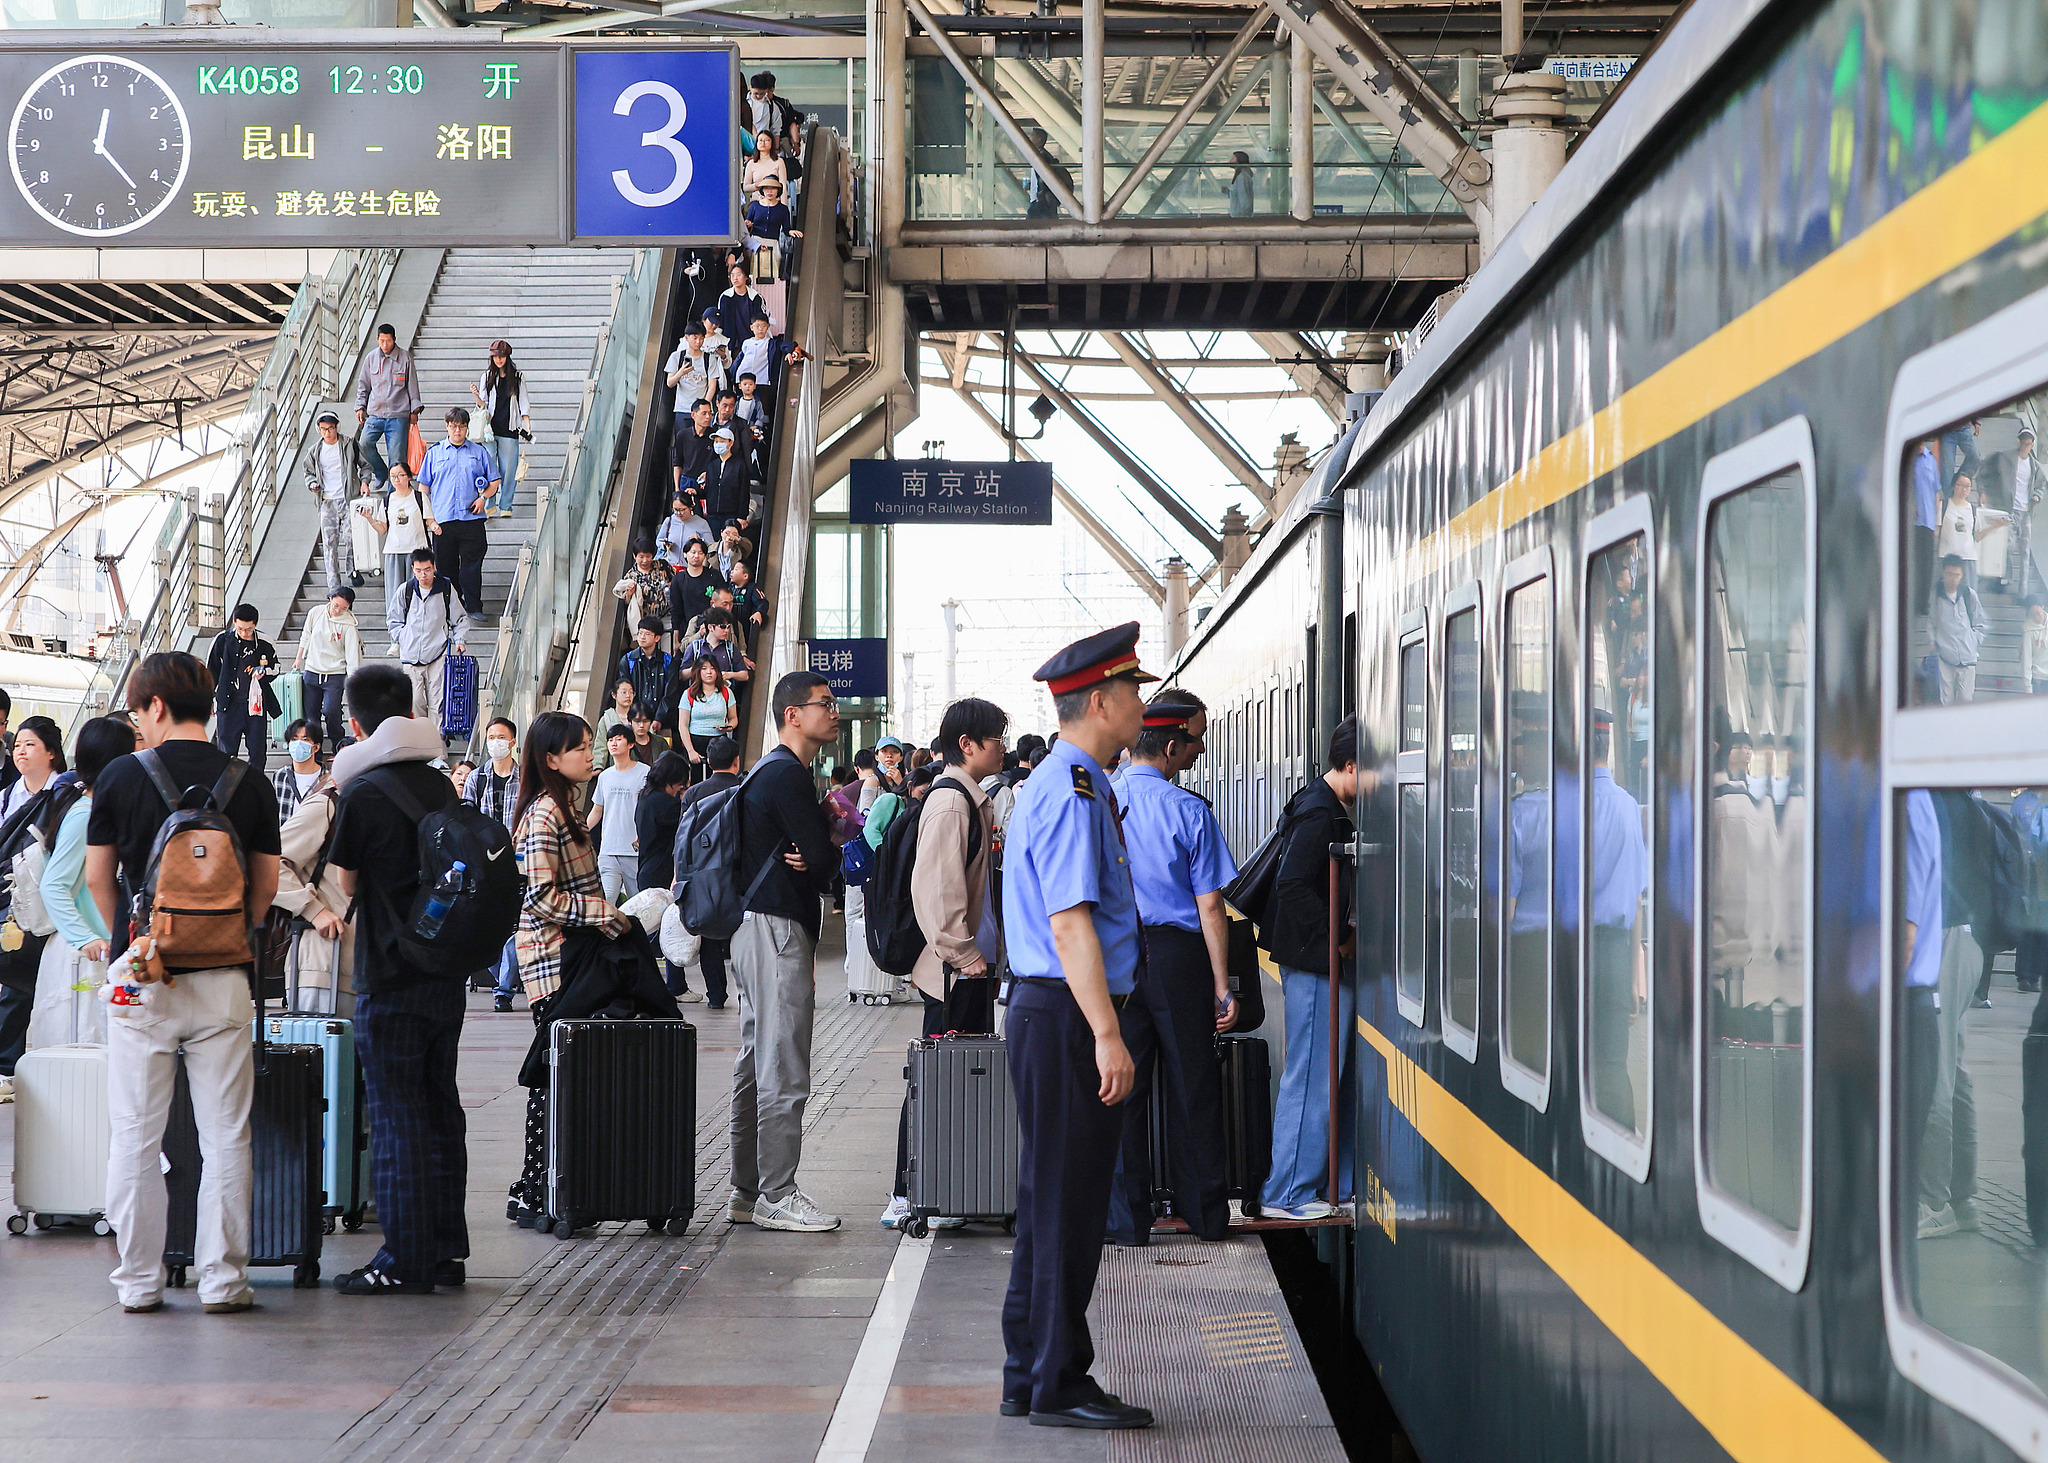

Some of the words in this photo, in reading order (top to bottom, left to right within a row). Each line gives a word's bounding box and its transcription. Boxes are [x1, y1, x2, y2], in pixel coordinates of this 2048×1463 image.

[91, 75, 109, 88] 12
[198, 65, 299, 95] K4058
[328, 65, 424, 95] 12:30
[482, 63, 520, 100] 开
[60, 84, 76, 97] 11
[127, 83, 135, 96] 1
[36, 107, 53, 121] 10
[149, 107, 159, 120] 2
[30, 139, 40, 152] 9
[158, 138, 168, 151] 3
[242, 123, 316, 160] 昆山
[435, 123, 513, 160] 洛阳
[610, 80, 694, 208] 3
[39, 171, 49, 184] 8
[149, 169, 159, 182] 4
[64, 194, 73, 206] 7
[127, 193, 137, 206] 5
[192, 190, 442, 217] 玩耍、避免发生危险
[95, 203, 105, 216] 6
[902, 468, 1002, 498] 南京站
[875, 502, 924, 516] Nanjing
[928, 502, 978, 517] Railway
[982, 502, 1028, 515] Station
[811, 650, 853, 672] 电梯
